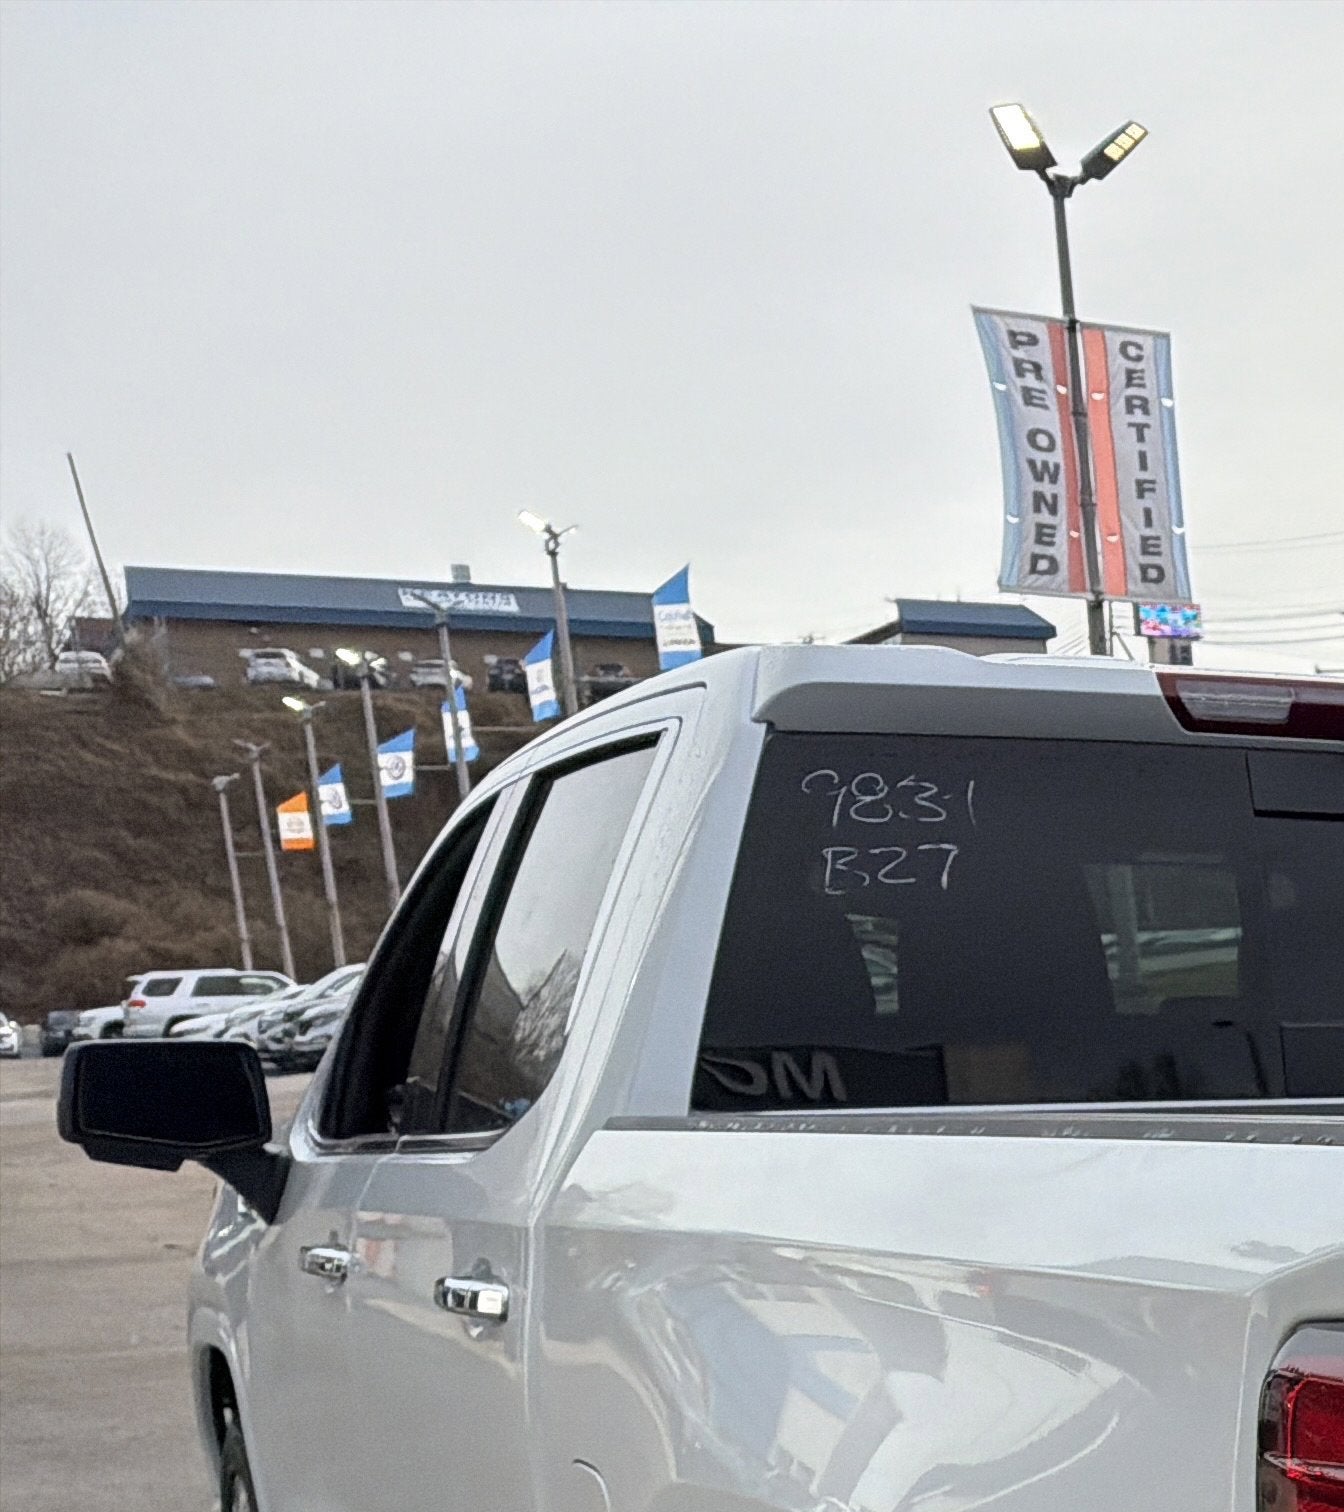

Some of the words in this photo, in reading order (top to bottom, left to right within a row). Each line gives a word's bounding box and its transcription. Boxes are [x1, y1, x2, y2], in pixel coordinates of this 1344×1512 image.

[1006, 329, 1050, 410] PRE
[1026, 428, 1061, 577] OWNED
[1118, 340, 1166, 585] CERTIFIED
[802, 769, 976, 827] 9831
